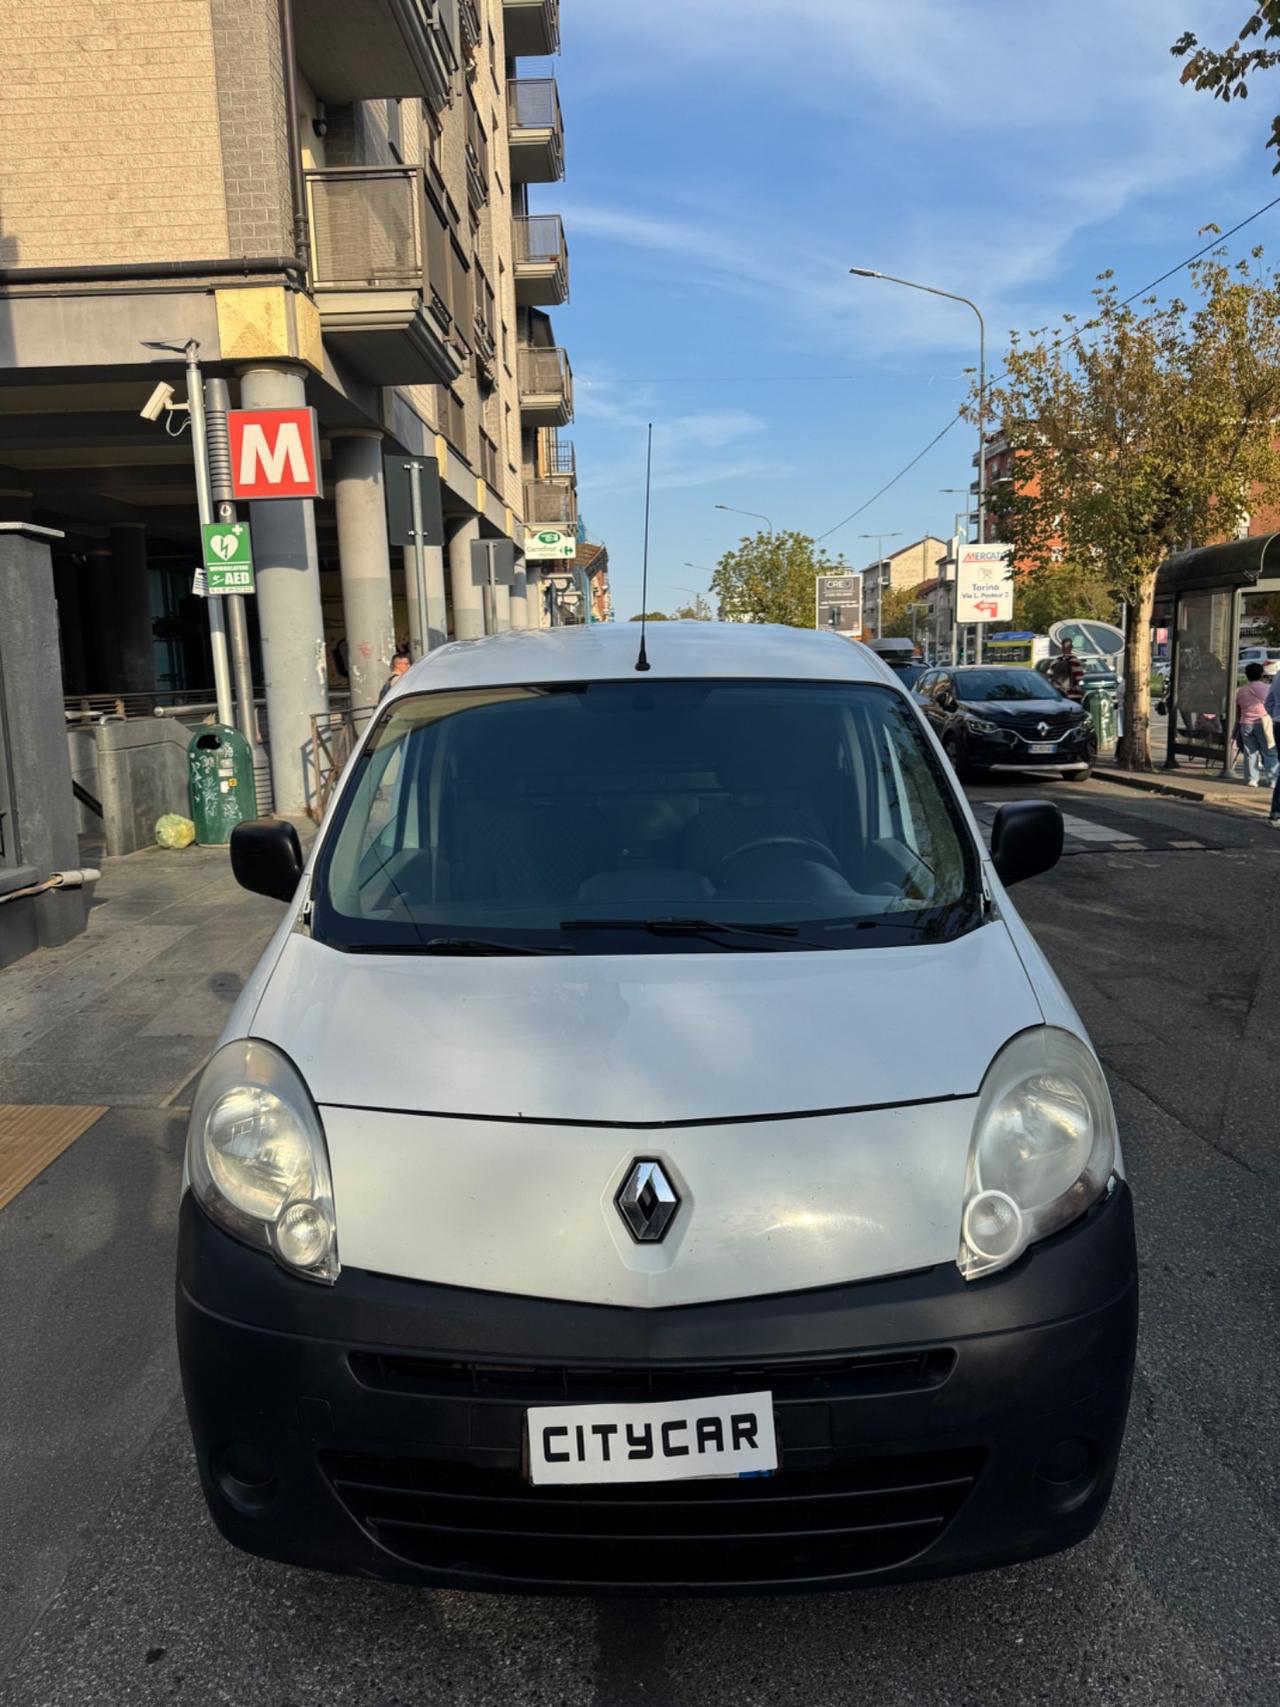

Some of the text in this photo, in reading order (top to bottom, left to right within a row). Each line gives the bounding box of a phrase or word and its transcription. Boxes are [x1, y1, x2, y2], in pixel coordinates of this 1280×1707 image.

[240, 422, 310, 485] M
[225, 572, 250, 585] AED
[972, 583, 1000, 591] Torino
[542, 1413, 759, 1462] CITYCAR
